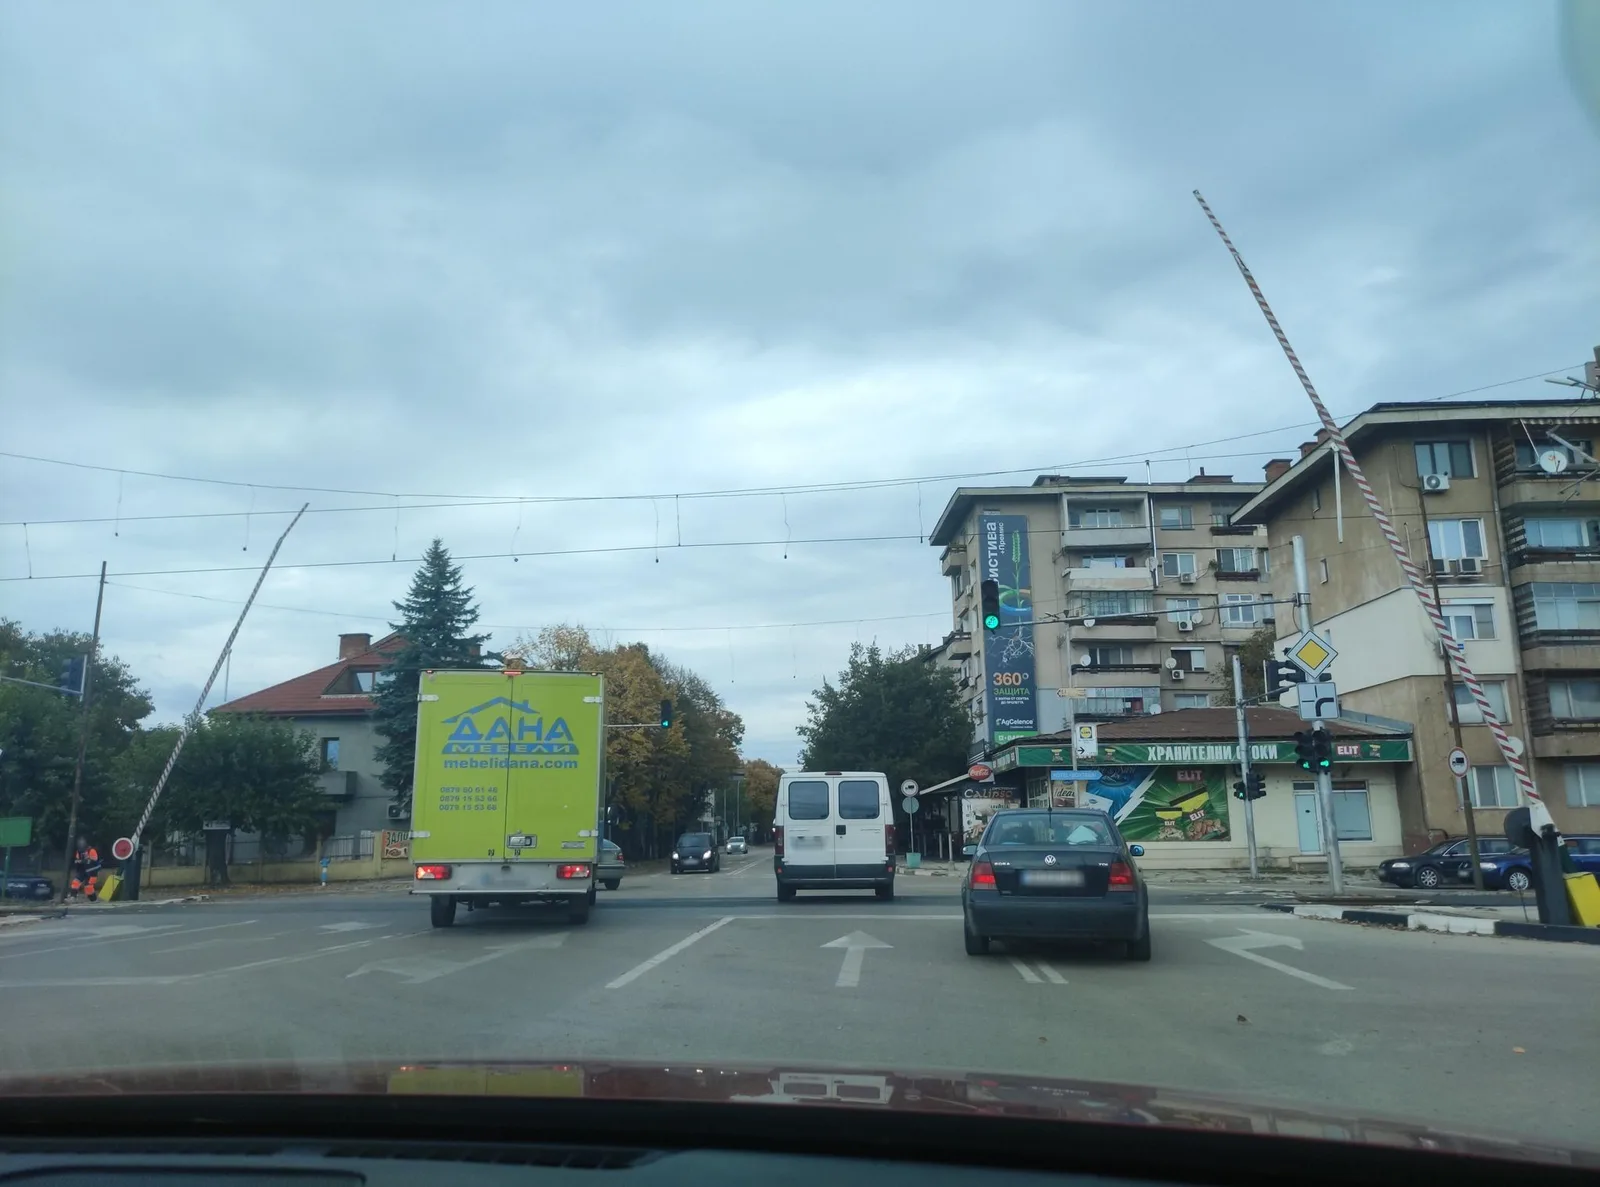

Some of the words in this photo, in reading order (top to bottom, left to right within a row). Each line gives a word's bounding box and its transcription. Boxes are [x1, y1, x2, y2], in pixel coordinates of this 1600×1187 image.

[986, 522, 998, 583] истива
[993, 672, 1029, 686] 360°
[993, 687, 1030, 696] ЗАЩИТА
[448, 716, 574, 741] ДАНА
[1001, 718, 1033, 726] AgCelence
[452, 744, 569, 753] МЕБЕЛИ
[1147, 746, 1232, 761] ХРАНИТЕЛНИ
[1236, 745, 1278, 760] СОКИ
[444, 757, 578, 769] mebelidana.com
